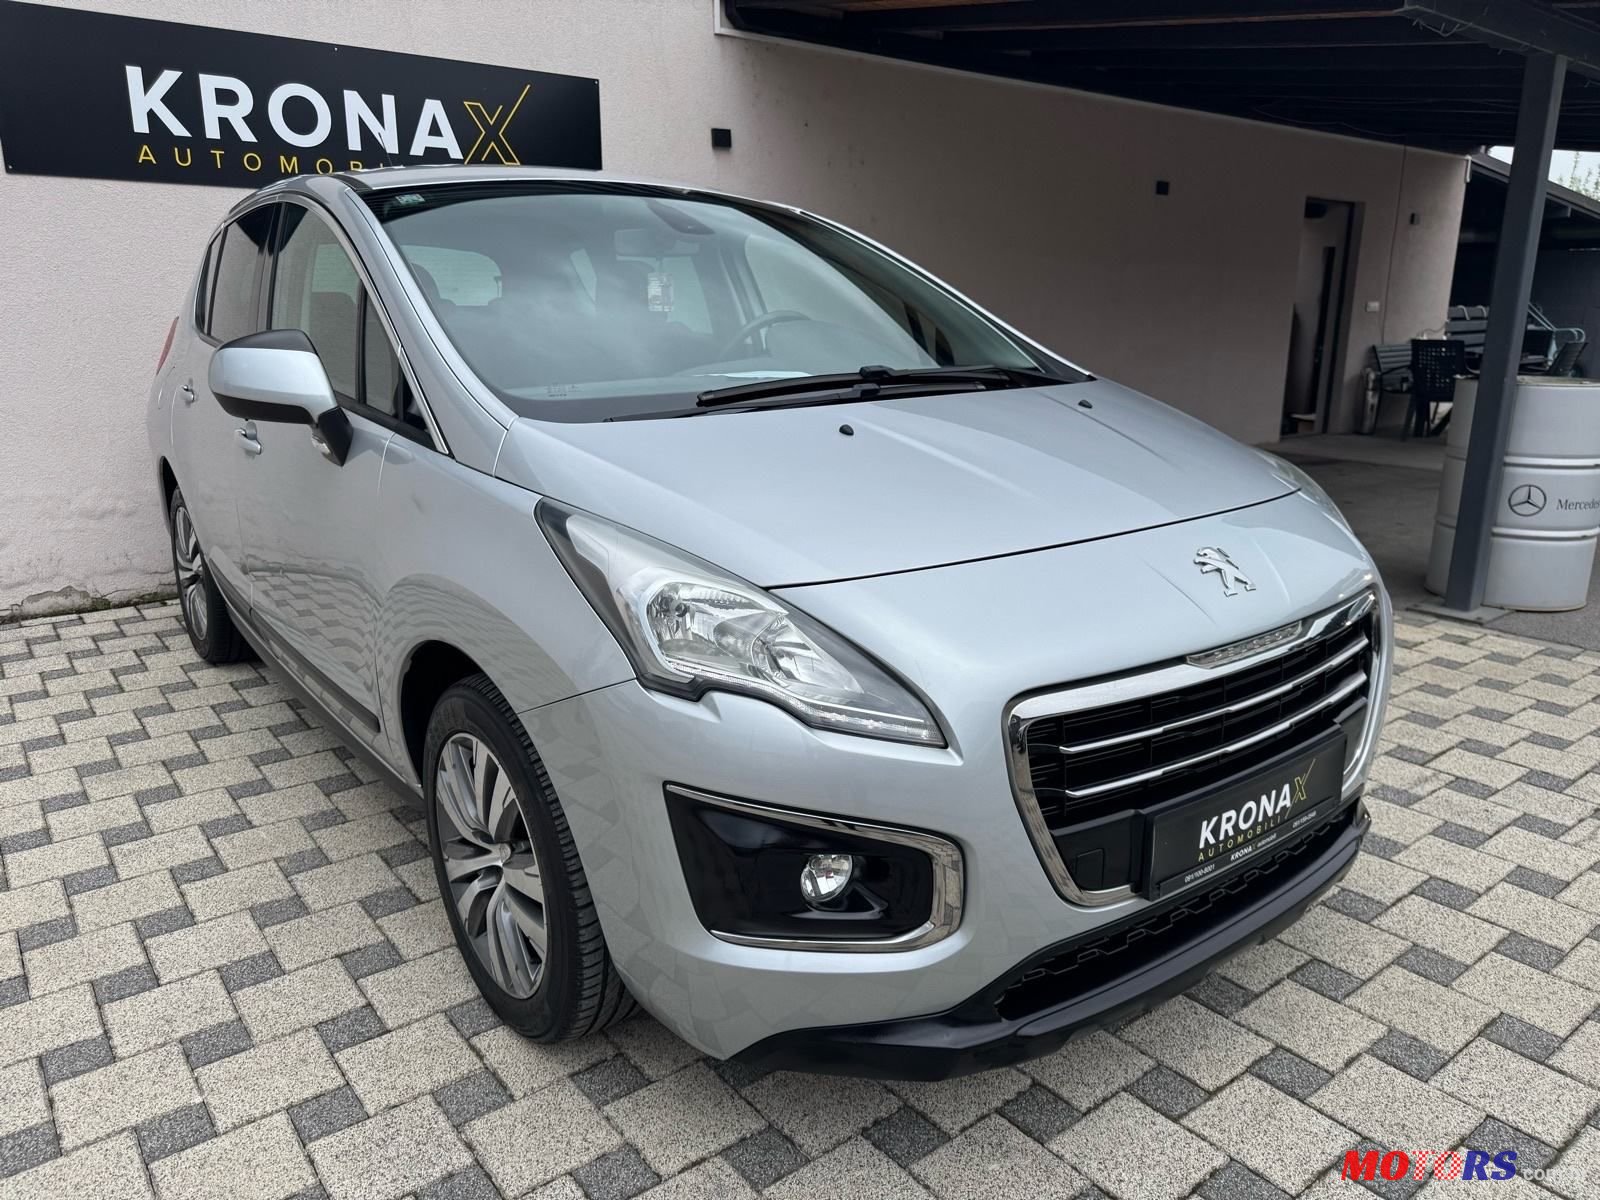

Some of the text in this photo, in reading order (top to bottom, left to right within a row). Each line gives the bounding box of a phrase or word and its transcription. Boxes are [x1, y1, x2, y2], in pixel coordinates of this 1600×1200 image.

[126, 65, 531, 165] KRONAX
[1198, 815, 1282, 862] AUTOMOBILI
[1199, 758, 1316, 849] KRONAX
